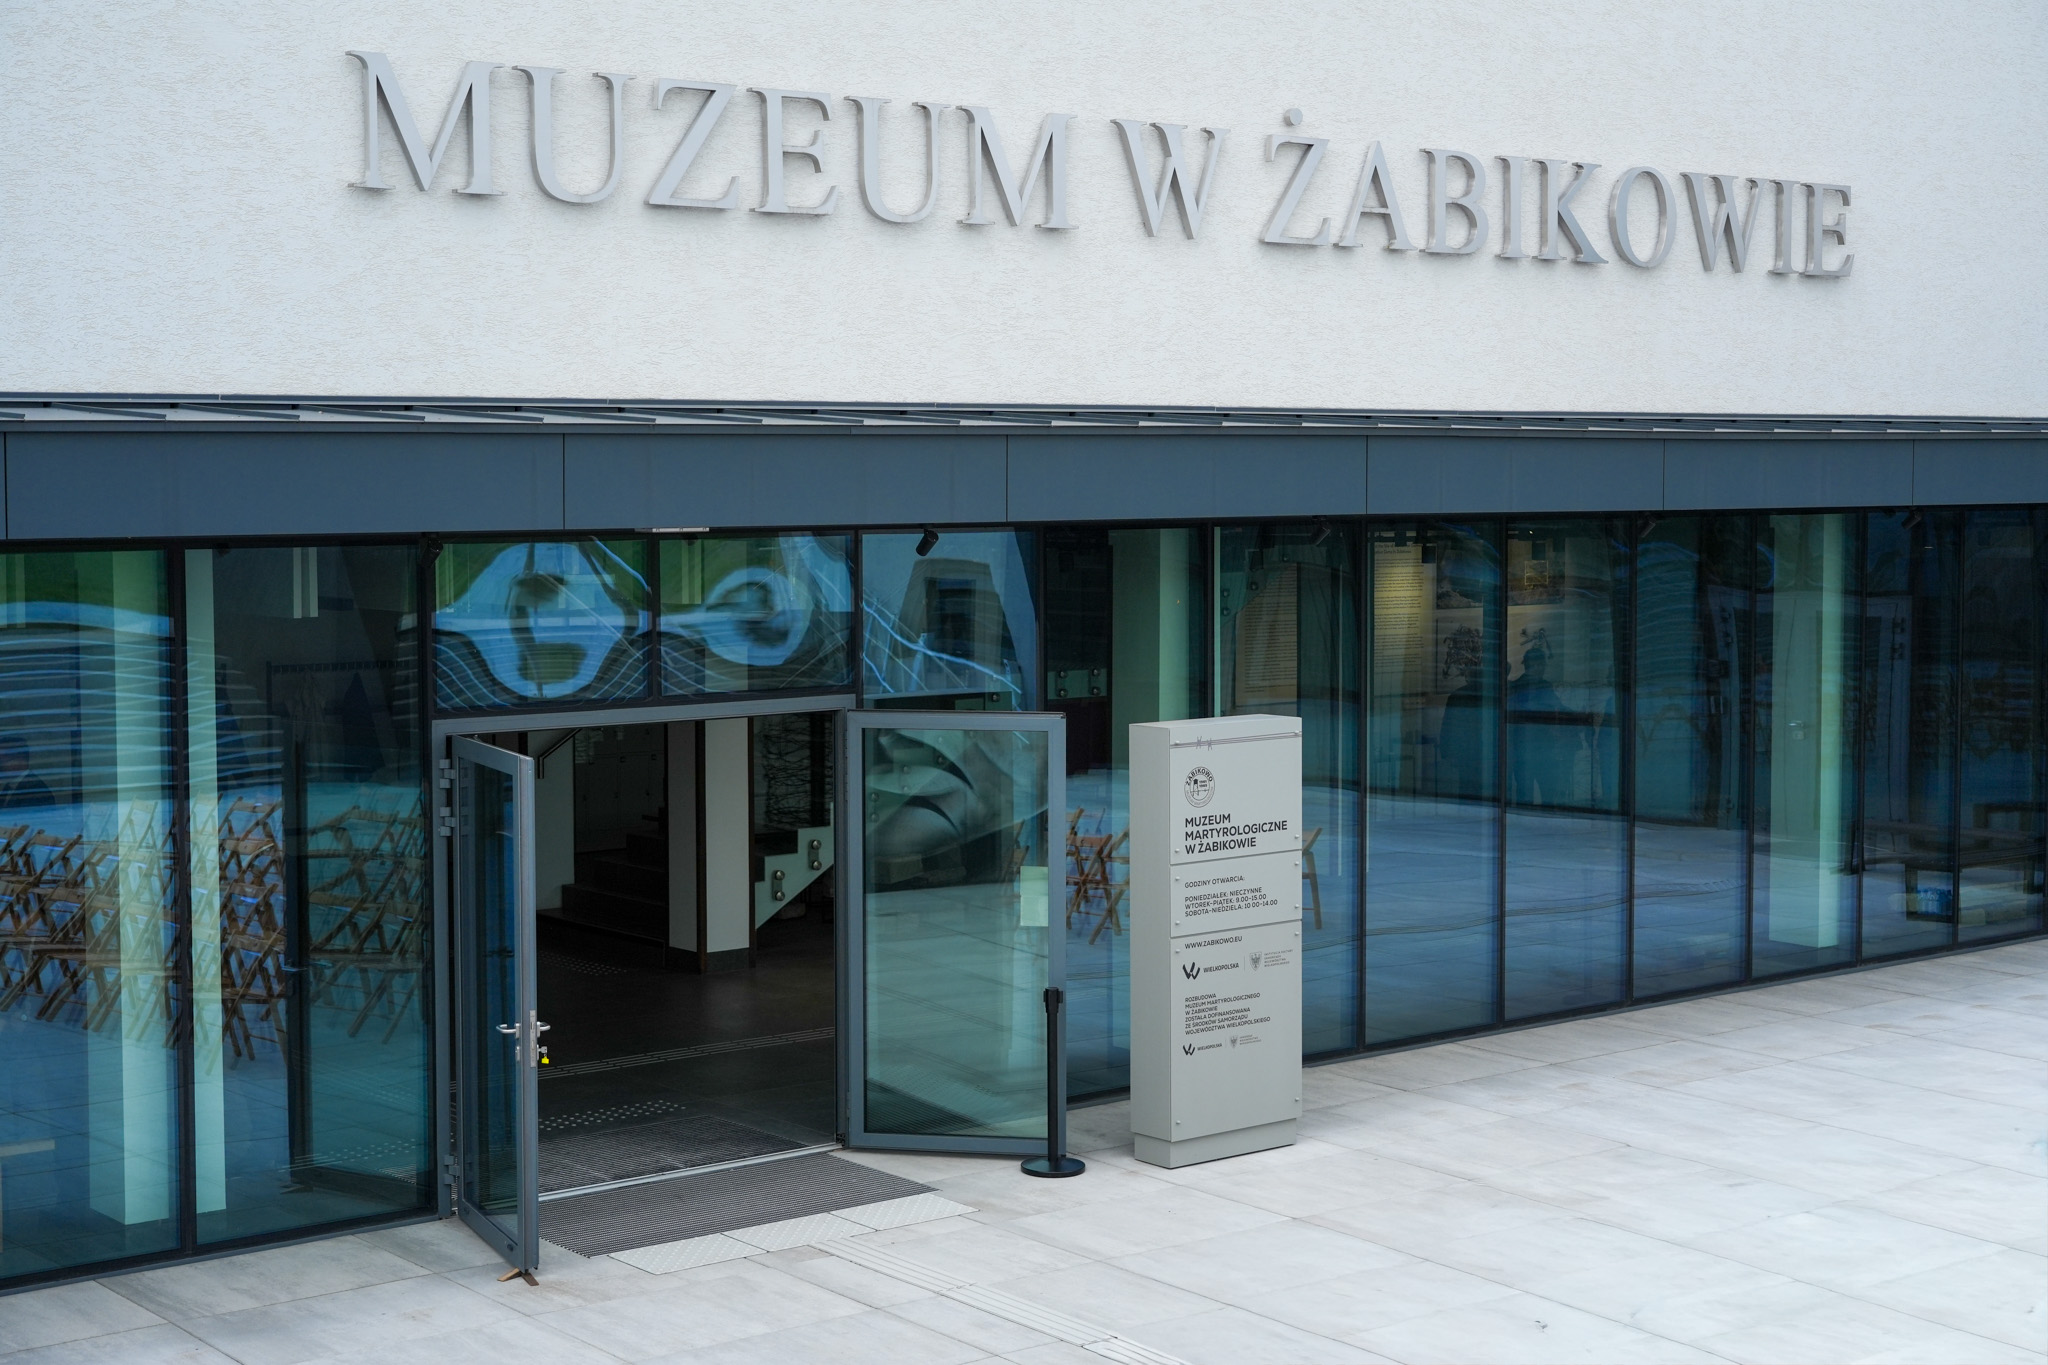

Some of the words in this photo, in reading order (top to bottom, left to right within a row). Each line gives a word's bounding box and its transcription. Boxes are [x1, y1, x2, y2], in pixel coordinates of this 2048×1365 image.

[345, 50, 1079, 231] MUZEUM
[1110, 118, 1231, 240] W
[1260, 107, 1855, 278] ŻABIKOWIE
[1185, 813, 1231, 828] MUZEUM
[1185, 820, 1288, 841] MARTYROLOGICZNE
[1185, 844, 1196, 854] W
[1198, 837, 1256, 853] ŻABIKOWIE
[1185, 880, 1211, 888] GODZINY
[1212, 875, 1245, 886] OTWARCIA:
[1185, 892, 1228, 902] PONIEDZIAŁEK:
[1230, 887, 1262, 896] NIECZYNNE
[1185, 898, 1234, 909] WTOREK-PIĄTEK:
[1185, 905, 1243, 917] SOBOTA-NIEDZIELA:
[1185, 936, 1243, 949] WWW.ZABIKOWO.EU
[1203, 962, 1239, 973] WIELKOPOLSKA
[1185, 993, 1216, 1002] ROZBUDOWA
[1185, 1001, 1206, 1009] MUZEUM
[1207, 992, 1260, 1006] MARTYROLOGICZNEGO
[1208, 1007, 1251, 1019] DOFINANSOWANA
[1185, 1021, 1191, 1029] ZE
[1226, 1016, 1271, 1029] WIELKOPOLSKIEGO
